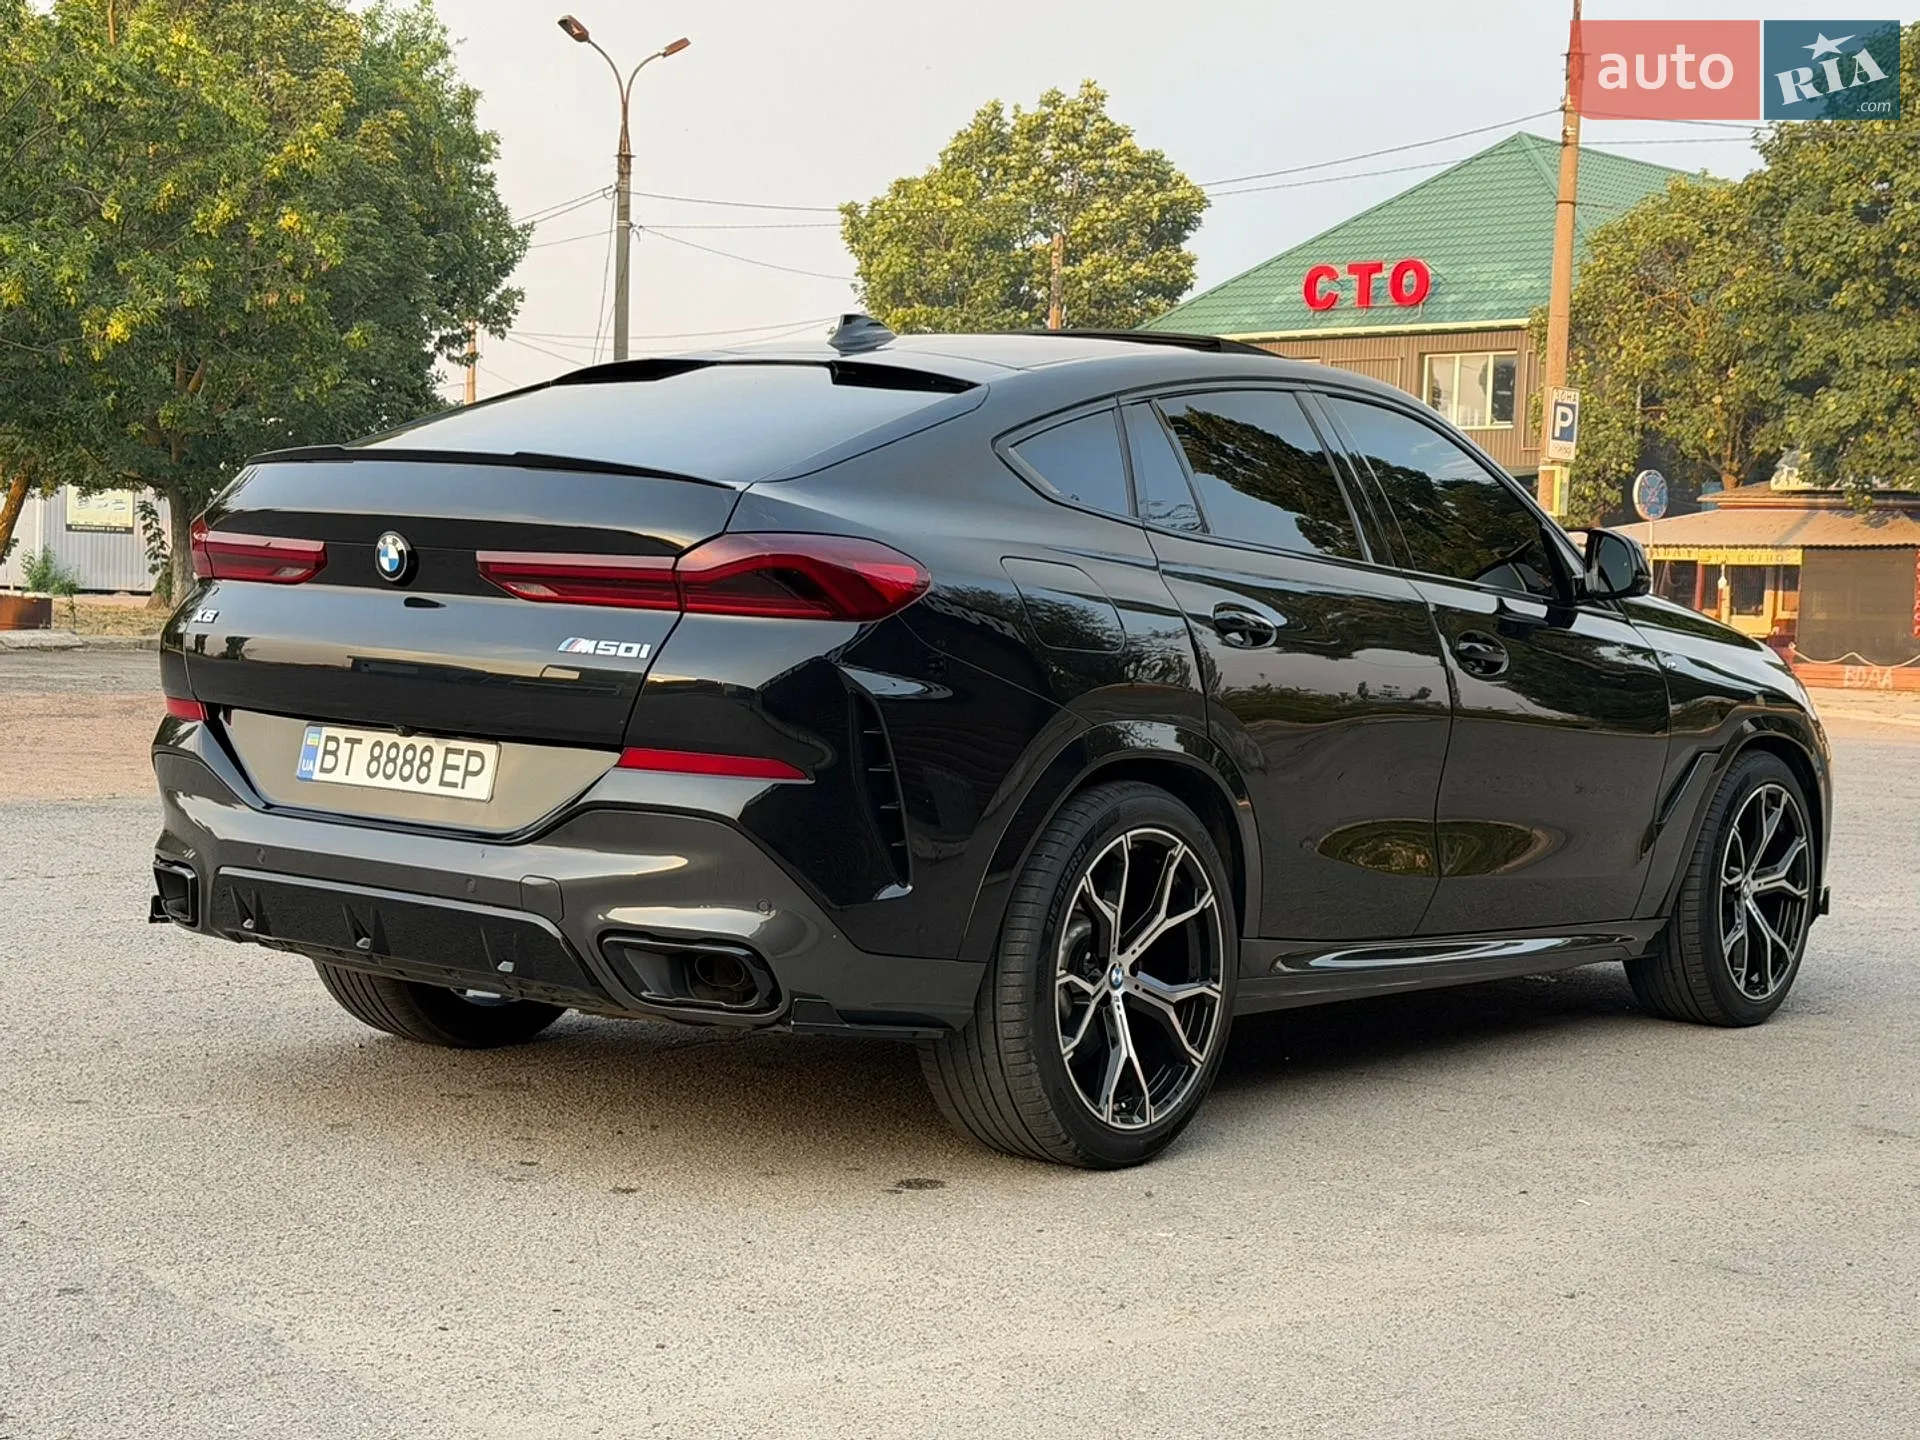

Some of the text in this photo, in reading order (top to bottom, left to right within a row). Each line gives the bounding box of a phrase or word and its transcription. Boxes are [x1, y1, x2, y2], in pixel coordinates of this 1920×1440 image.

[1303, 257, 1432, 312] СТО
[1554, 406, 1573, 438] P
[366, 740, 434, 784] 8888
